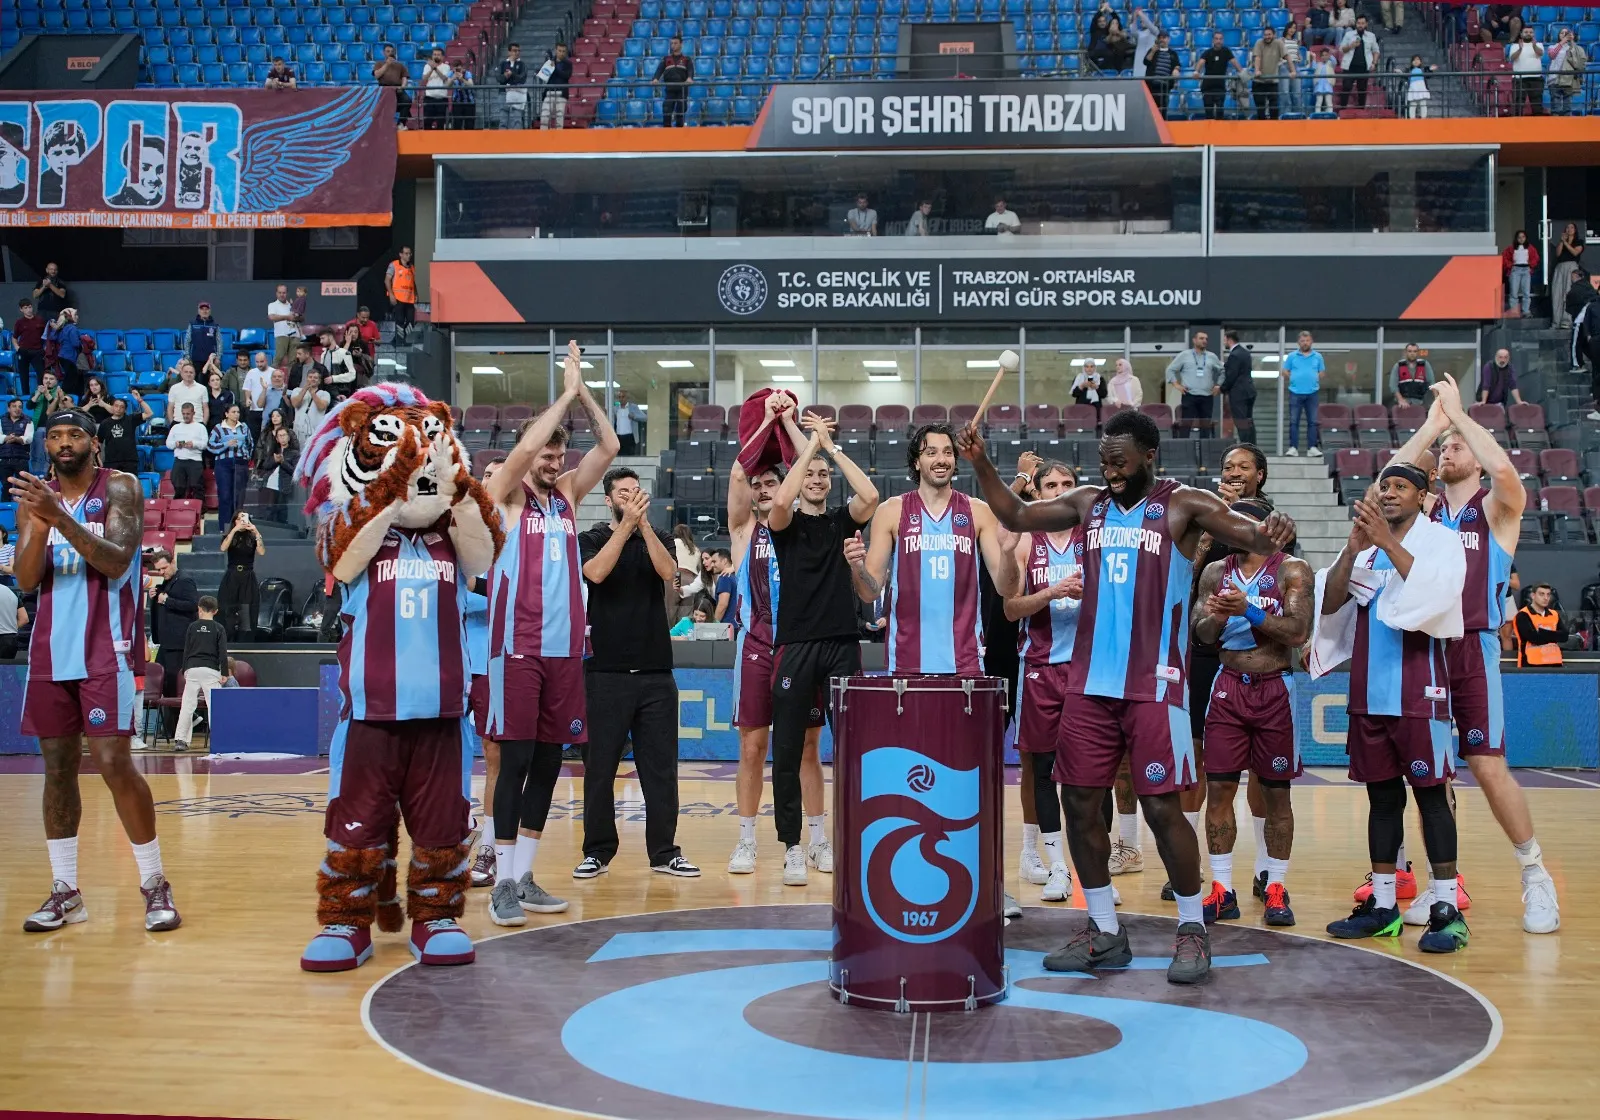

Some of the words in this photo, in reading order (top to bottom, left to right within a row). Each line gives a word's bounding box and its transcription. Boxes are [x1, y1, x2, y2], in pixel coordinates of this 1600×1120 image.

[791, 96, 875, 135] SPOR
[881, 95, 973, 136] ŞEHRİ
[979, 94, 1126, 132] TRABZON
[778, 272, 811, 287] T.C.
[816, 268, 901, 290] GENÇLİK
[906, 271, 931, 287] VE
[953, 271, 1029, 285] TRABZON
[1043, 267, 1135, 284] ORTAHİSAR
[777, 292, 828, 308] SPOR
[832, 289, 930, 308] BAKANLIĞI
[953, 288, 1010, 307] HAYRİ
[1015, 287, 1057, 306] GÜR
[1062, 290, 1116, 306] SPOR
[1121, 289, 1202, 306] SALONU
[550, 537, 561, 562] 8
[904, 533, 972, 556] TRABZONSPOR
[1086, 526, 1163, 556] TRABZONSPOR
[60, 547, 79, 575] 17
[928, 555, 949, 580] 19
[1105, 552, 1129, 583] 15
[400, 587, 429, 619] 61
[902, 911, 939, 927] 1967
